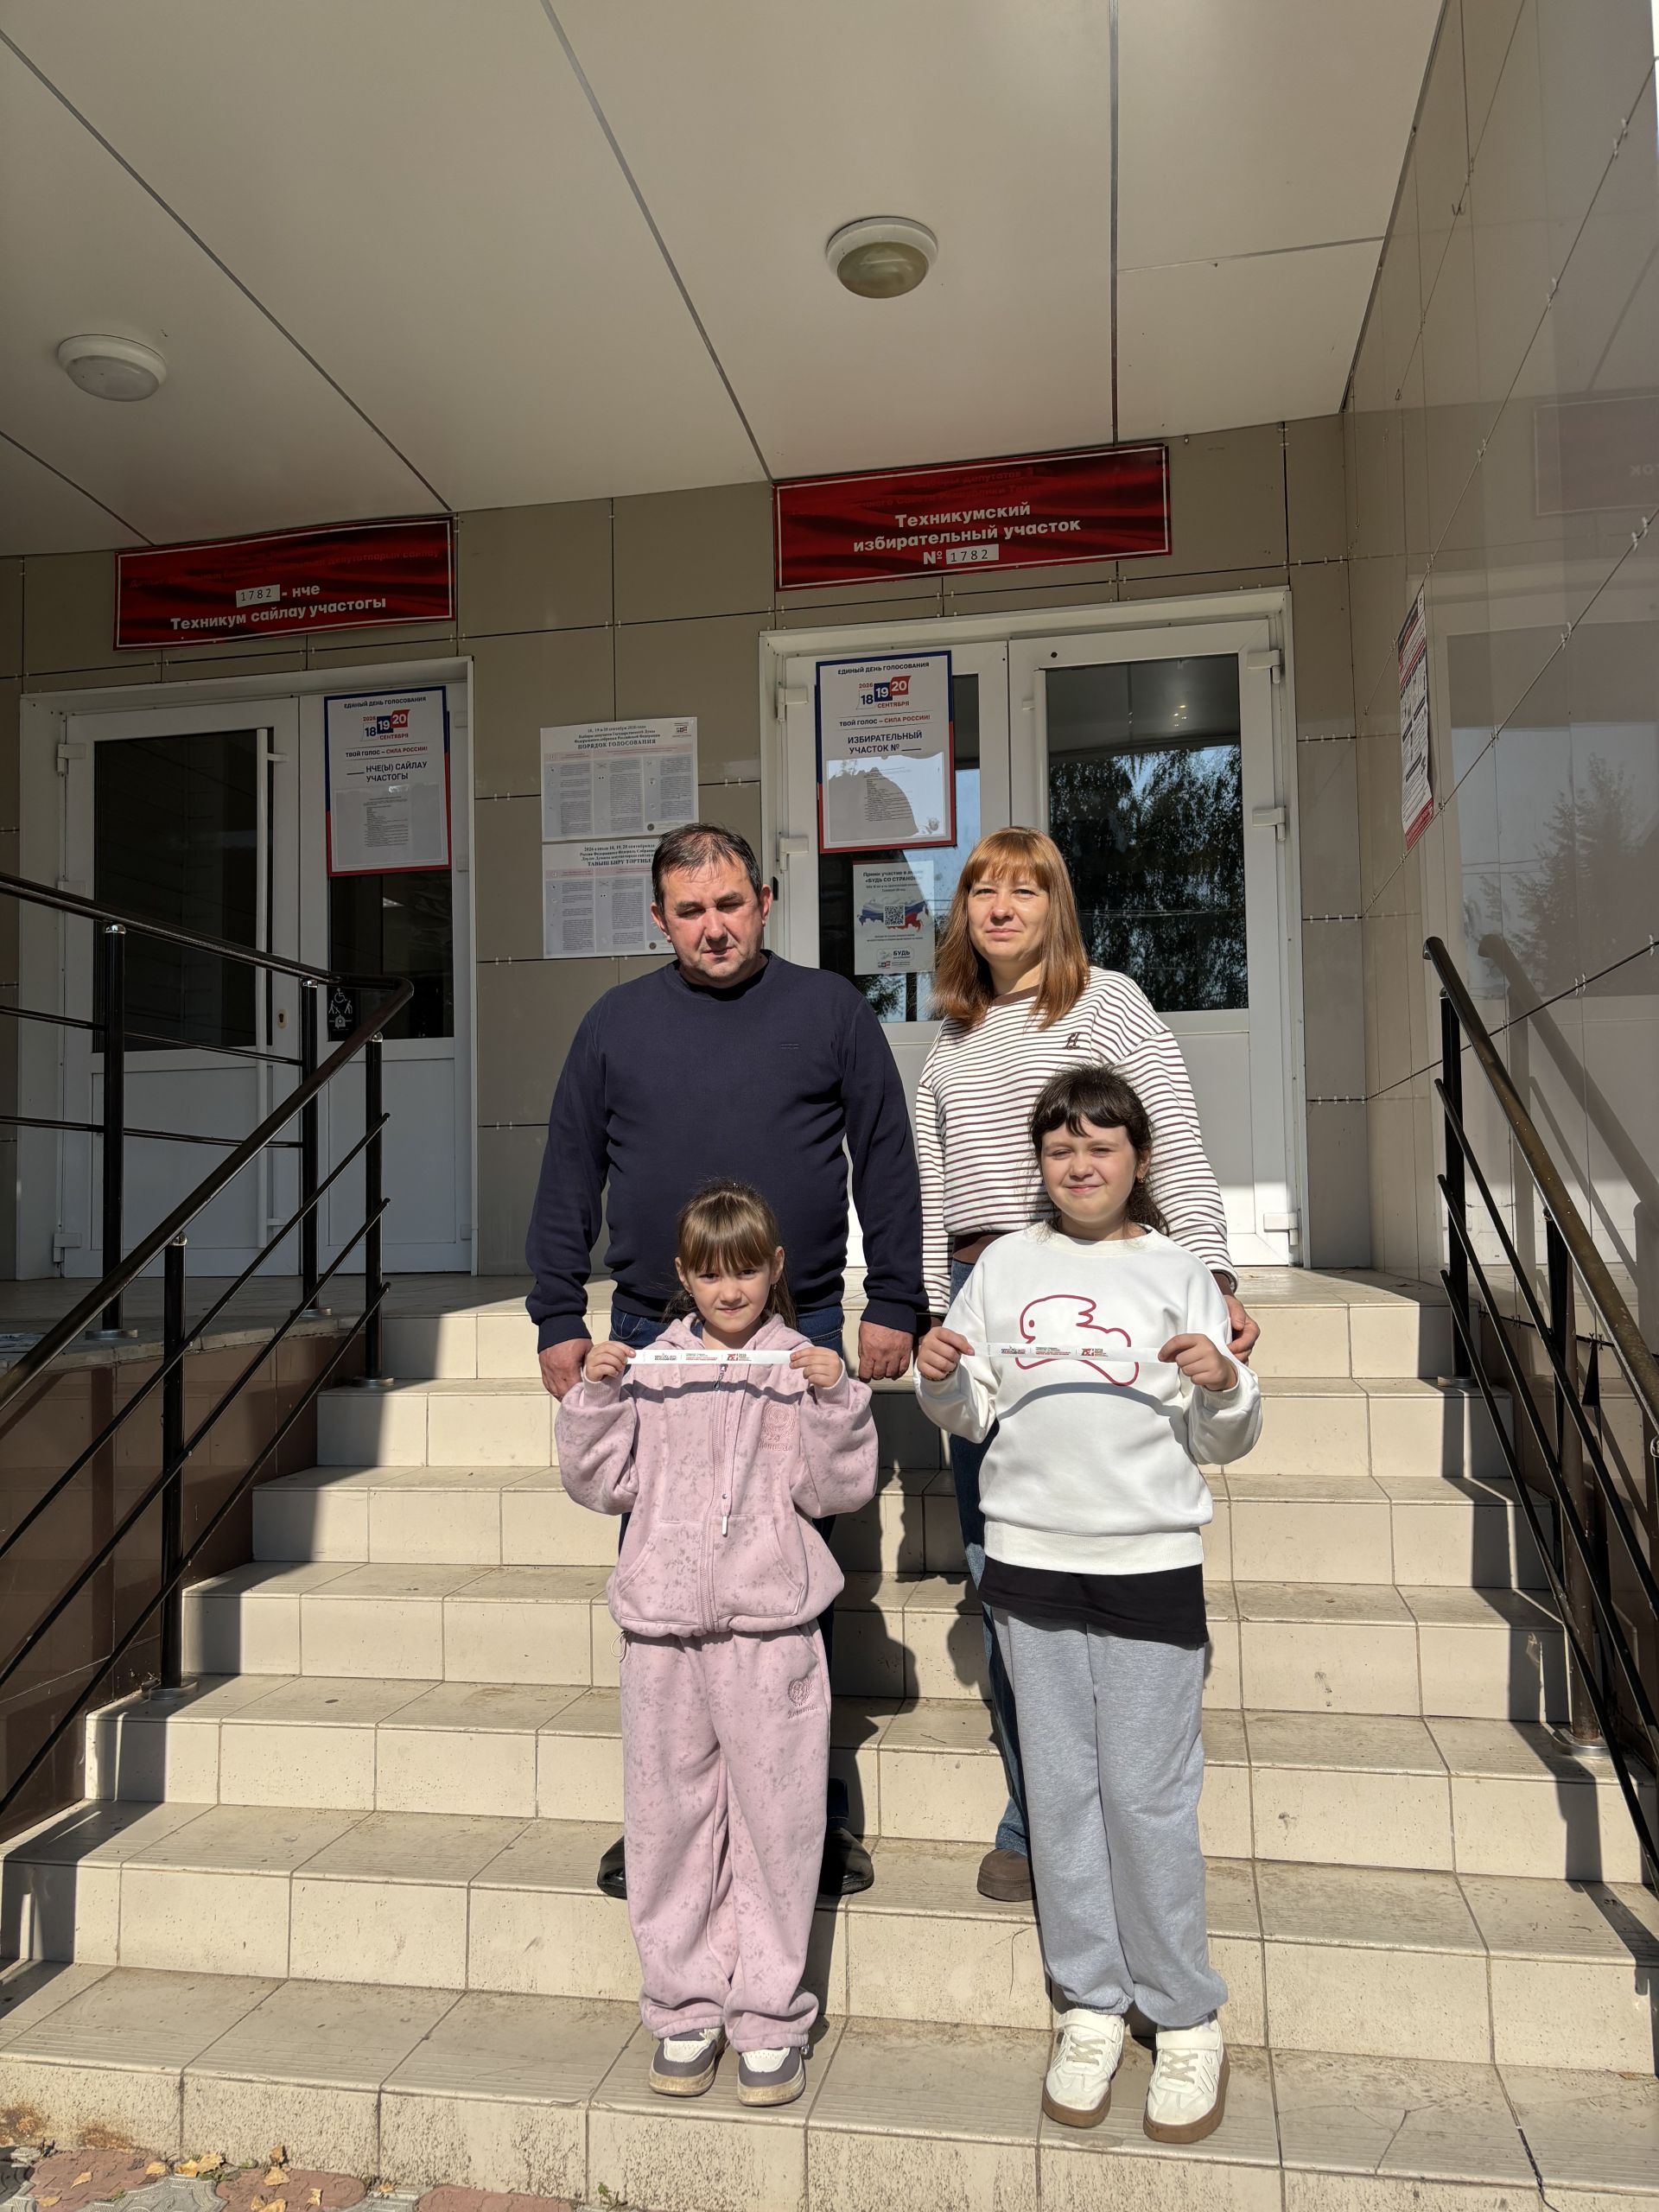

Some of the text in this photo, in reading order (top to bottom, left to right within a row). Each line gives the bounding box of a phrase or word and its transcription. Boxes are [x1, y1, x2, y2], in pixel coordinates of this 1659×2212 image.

[895, 502, 1031, 529] Техникумский
[853, 518, 1081, 553] избирательный участок
[923, 548, 989, 565] № 1782
[240, 587, 273, 602] 1782
[292, 584, 321, 598] нче
[171, 597, 386, 631] Техникум сайлау участогы
[837, 666, 865, 675] ЕДИНЫЙ
[883, 662, 930, 671] ГОЛОСОВАНИЯ
[861, 680, 907, 705] 18 19 20
[365, 714, 407, 737] 18 19 20
[608, 739, 656, 747] ГОЛОСОВАНИЯ
[848, 730, 923, 744] ИЗБИРАТЕЛЬНЫЙ
[849, 745, 889, 754] УЧАСТОК
[365, 760, 428, 773] НЧЕ(Ы) САЙЛАУ
[365, 772, 409, 782] УЧАСТОГЫ
